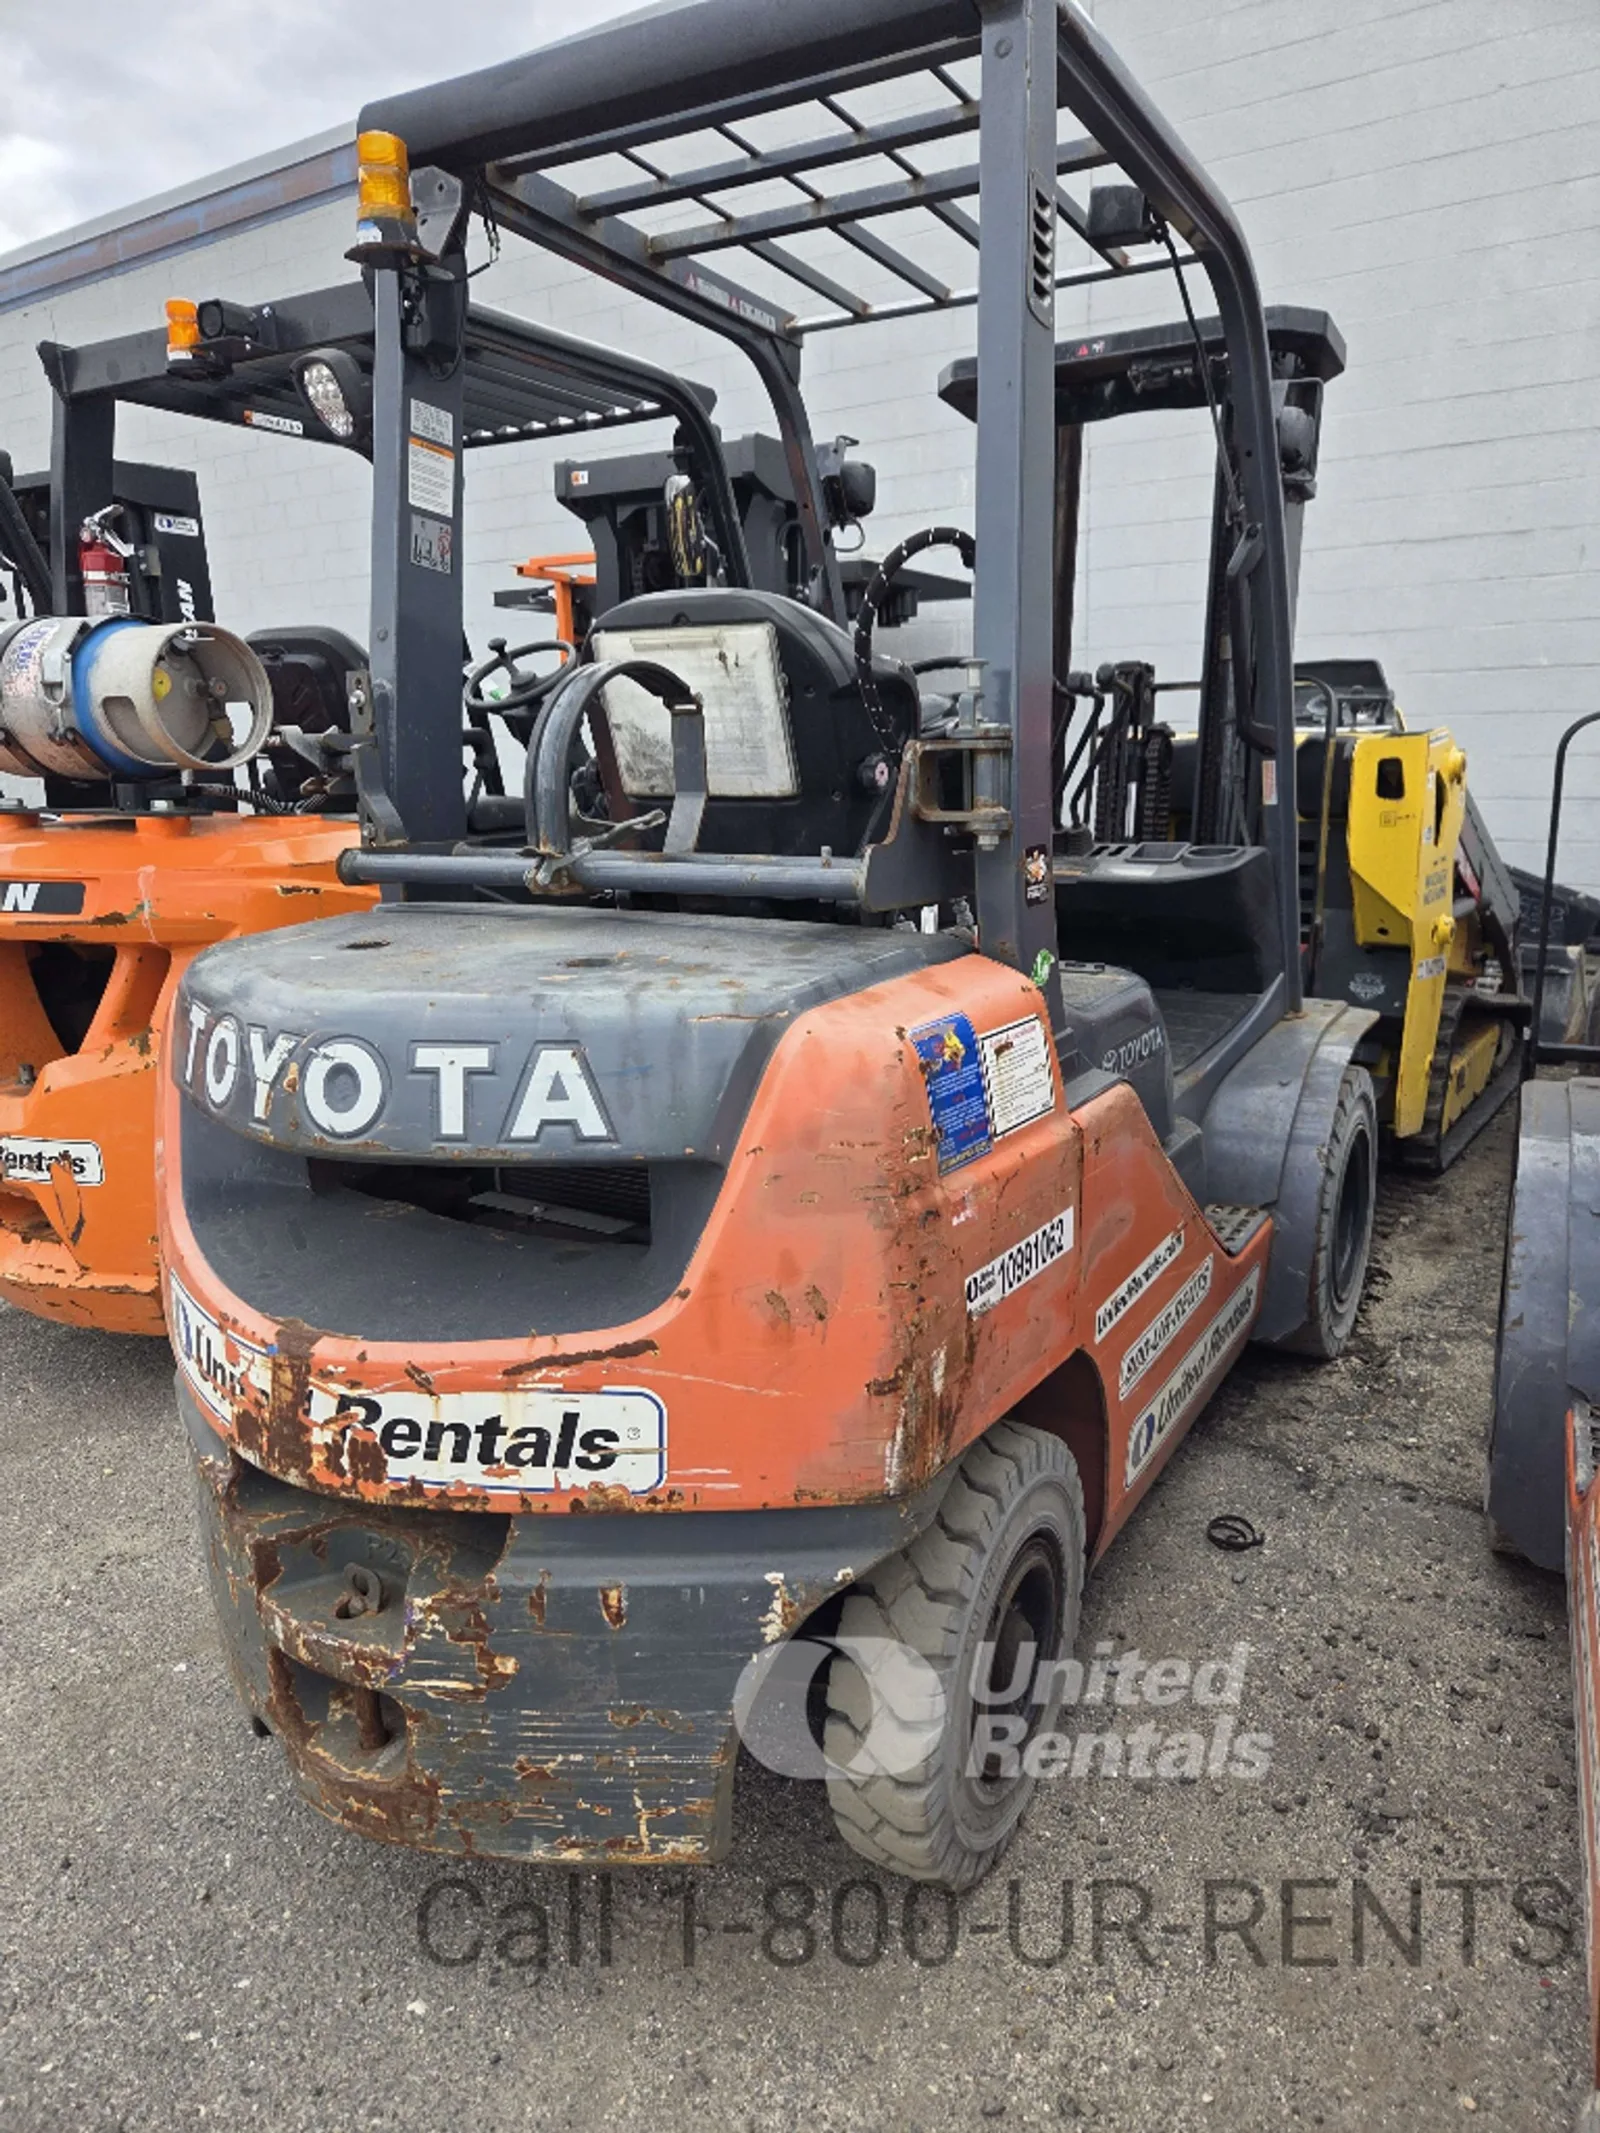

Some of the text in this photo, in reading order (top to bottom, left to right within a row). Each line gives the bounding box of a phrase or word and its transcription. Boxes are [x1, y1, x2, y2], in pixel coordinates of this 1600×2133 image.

[2, 883, 41, 911] N
[185, 1000, 609, 1139] TOYOTA
[1119, 1026, 1164, 1070] TOYOTA
[0, 1146, 87, 1174] entas
[998, 1218, 1064, 1295] 10991062
